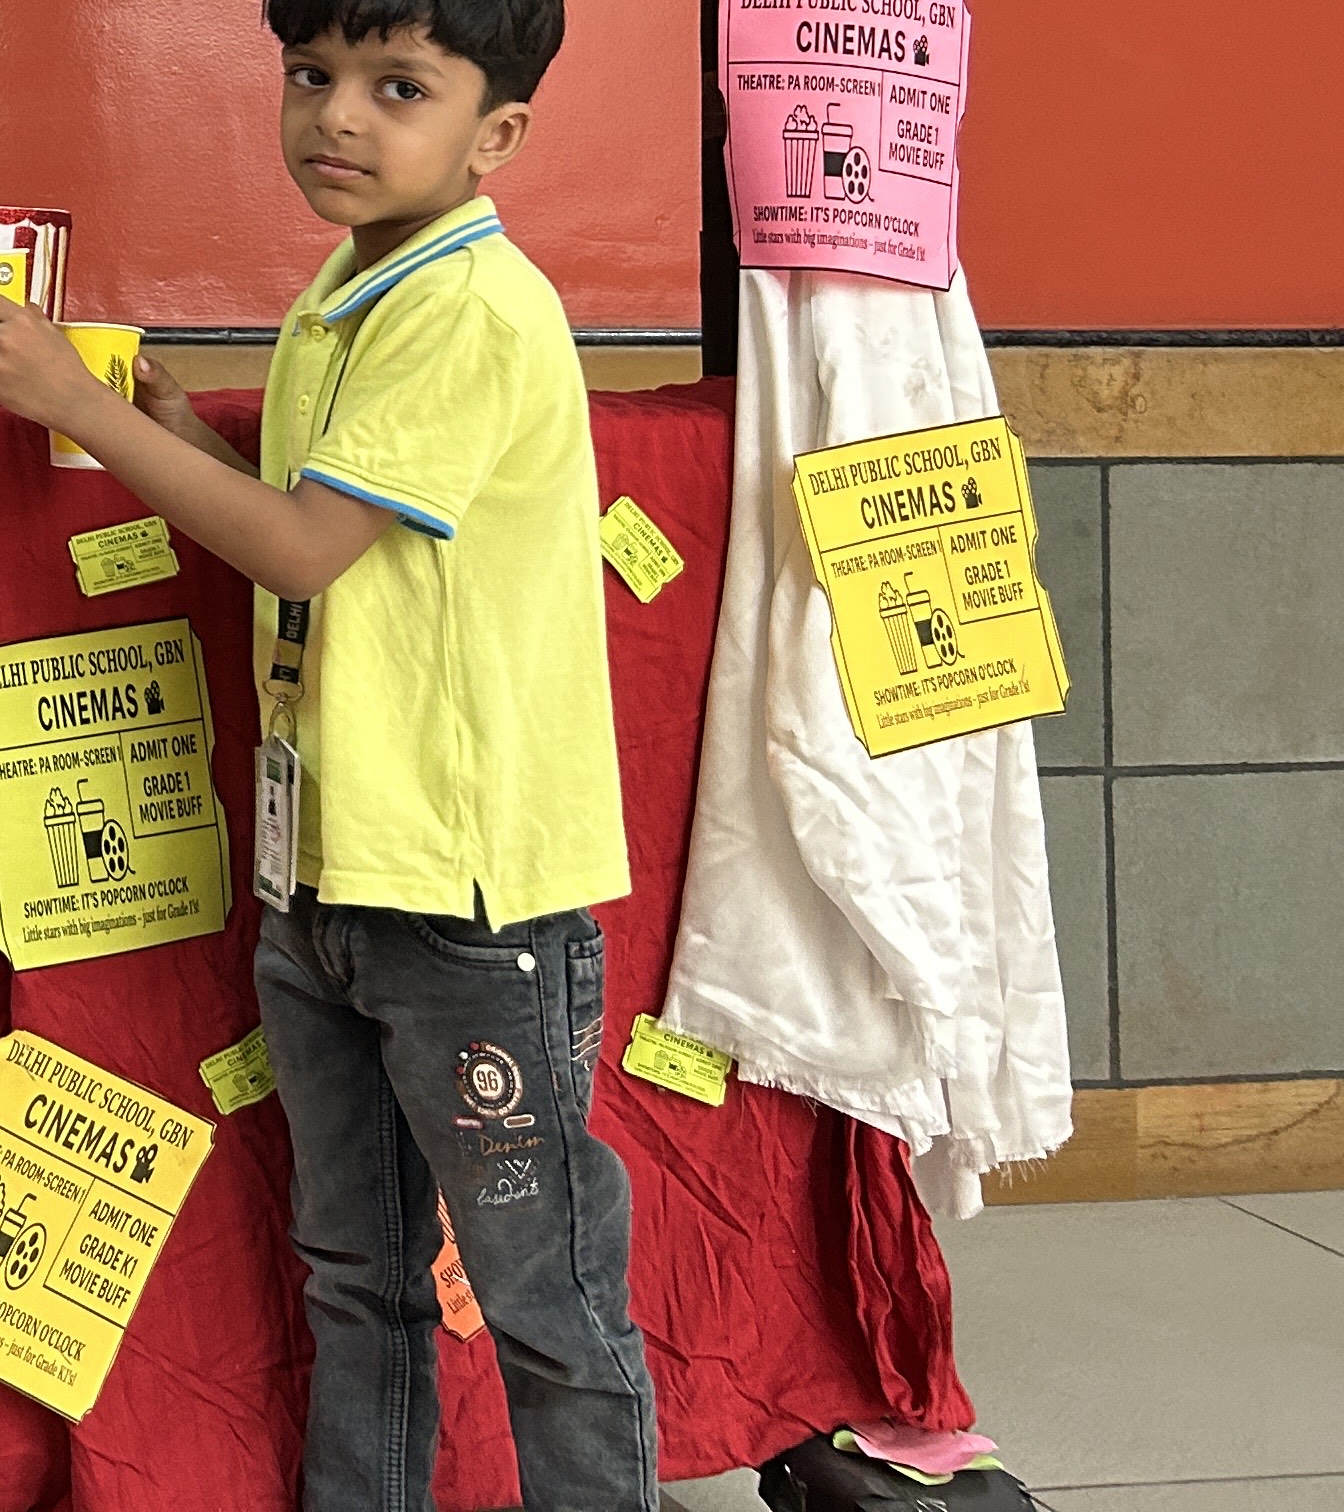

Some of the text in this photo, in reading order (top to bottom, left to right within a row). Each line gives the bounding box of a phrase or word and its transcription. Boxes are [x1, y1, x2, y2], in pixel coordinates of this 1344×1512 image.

[929, 3, 955, 29] GBN
[796, 21, 906, 62] CINEMAS
[738, 75, 875, 97] THEATRE: PA ROOM-SCREEN
[889, 85, 951, 114] ADMIT ONE
[897, 120, 938, 144] GRADE 1
[889, 143, 945, 171] MOVIE BUFF
[753, 206, 919, 237] SHOWTIME: IT'S POPCORN O'CLOCK
[808, 437, 1002, 496] DELHI PUBLIC SCHOOL, GBN
[860, 480, 956, 529] CINEMAS
[98, 533, 138, 548] CINEMAS
[633, 522, 663, 556] CINEMAS
[950, 526, 1018, 554] ADMIT ONE
[964, 560, 1011, 586] GRADE 1
[962, 582, 1024, 610] MOVIE BUFF
[31, 653, 86, 684] PUBLIC
[88, 644, 153, 676] SCHOOL,
[154, 639, 184, 665] GBN
[38, 684, 139, 732] CINEMAS
[39, 757, 52, 773] PA
[53, 747, 117, 771] ROOM-SCREEN
[130, 734, 198, 762] ADMIT ONE
[143, 771, 191, 797] GRADE 1
[140, 796, 203, 824] MOVIE BUFF
[24, 876, 189, 919] SHOWTIME: IT'S POPCORN O'CLOCK
[664, 1034, 704, 1054] CINEMAS
[6, 1039, 195, 1151] DELHI PUBLIC SCHOOL, GBN
[476, 1070, 499, 1091] 96
[24, 1093, 137, 1173] CINEMAS
[1, 1148, 17, 1169] PA
[15, 1154, 83, 1203] ROOM-SCREEN
[89, 1199, 159, 1247] ADMIT ONE
[80, 1234, 139, 1278] GRADE K1
[60, 1258, 131, 1309] MOVIE BUFF
[39, 1324, 86, 1361] O'CLOCK
